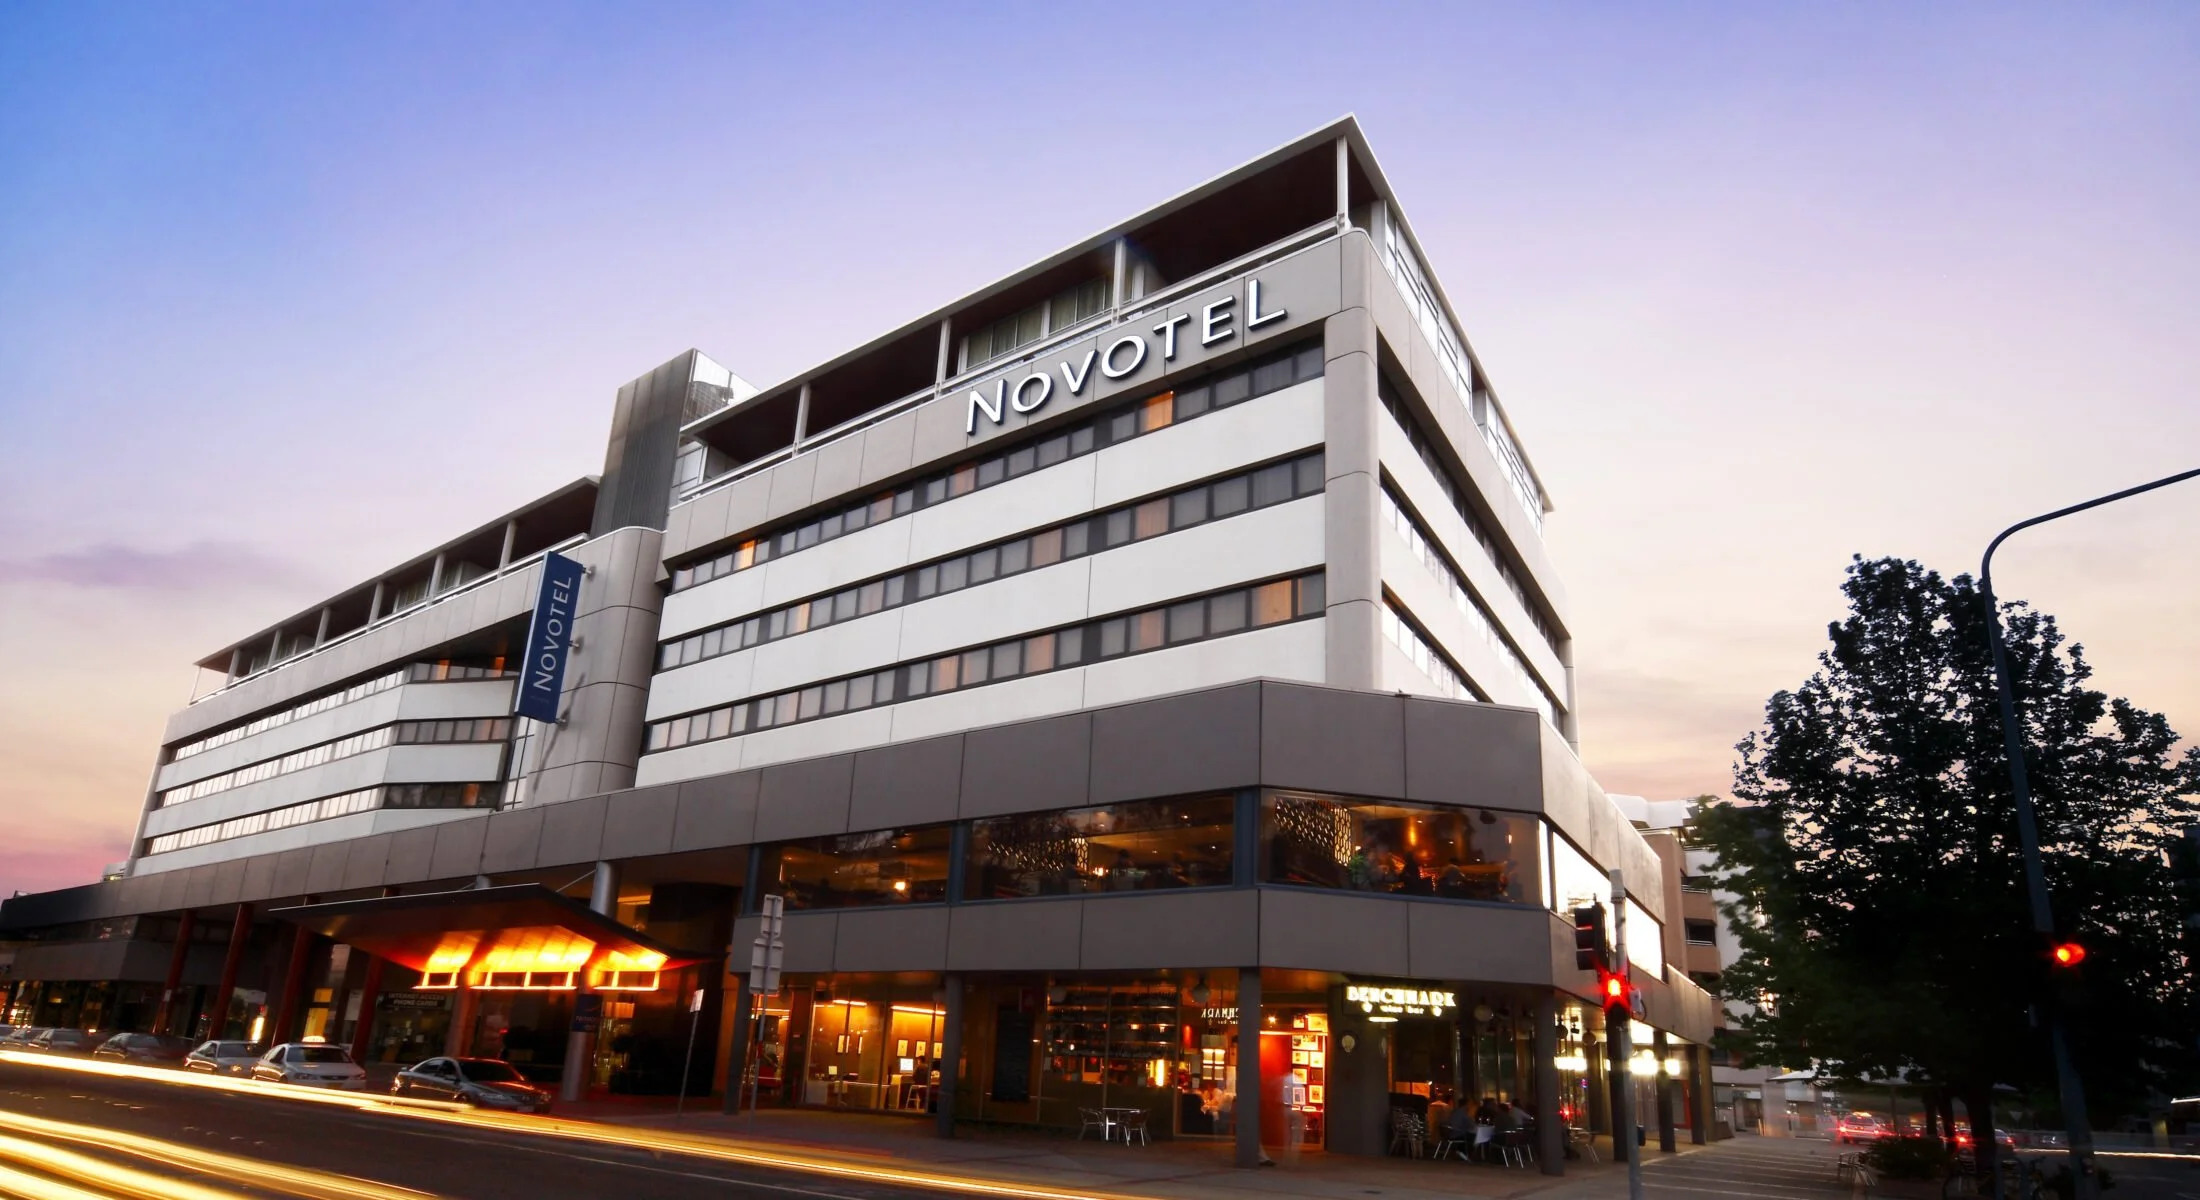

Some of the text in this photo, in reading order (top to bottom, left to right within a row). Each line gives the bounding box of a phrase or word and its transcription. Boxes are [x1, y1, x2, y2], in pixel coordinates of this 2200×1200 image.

[966, 279, 1288, 435] NOVOTEL
[533, 577, 572, 692] NOVOTEL
[1346, 986, 1456, 1007] BENCHMARK
